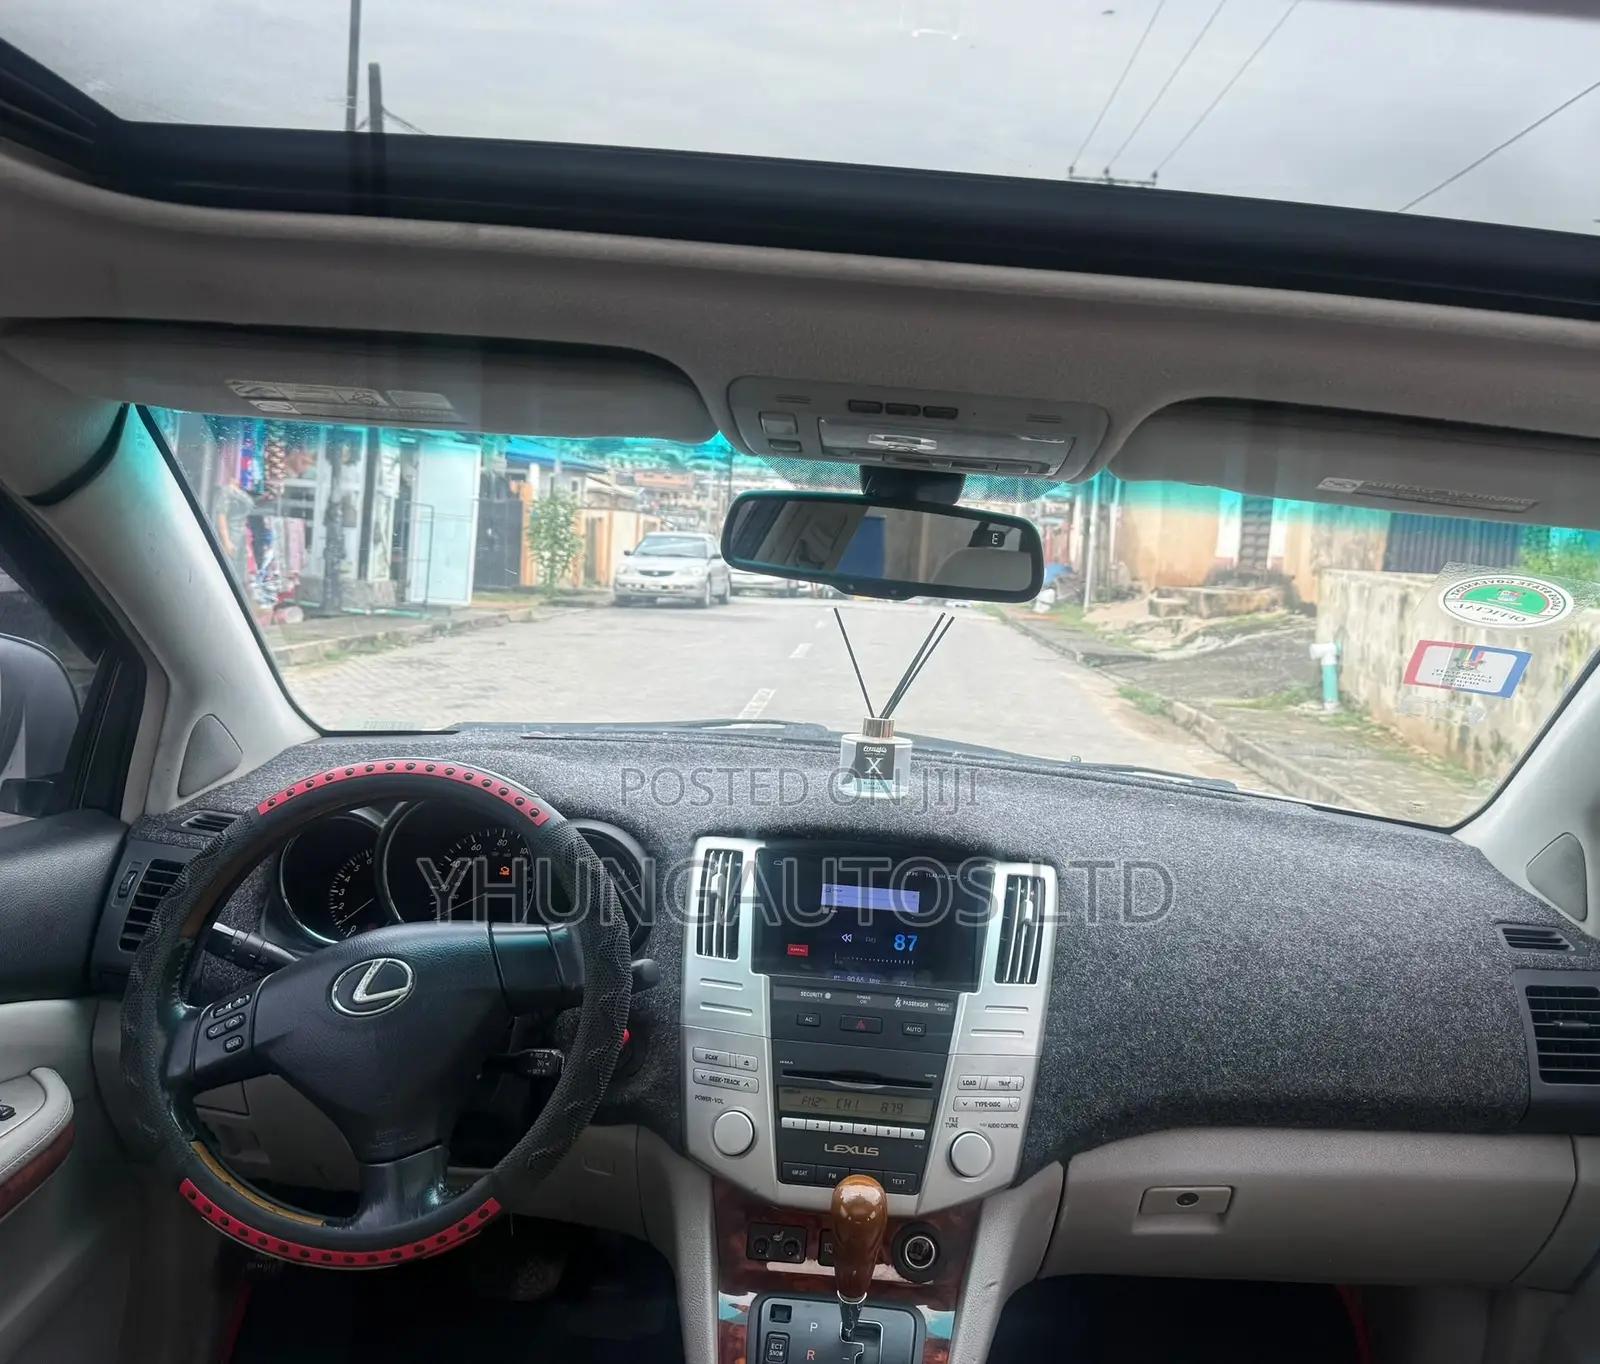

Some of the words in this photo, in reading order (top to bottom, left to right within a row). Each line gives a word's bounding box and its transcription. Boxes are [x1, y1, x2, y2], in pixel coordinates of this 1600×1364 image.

[991, 533, 999, 545] E
[865, 757, 884, 775] X
[893, 934, 919, 952] 87
[902, 1000, 929, 1008] PASSENGER
[704, 1053, 719, 1061] SCAN
[824, 1143, 880, 1157] LEXUS
[809, 1322, 818, 1332] P
[806, 1350, 815, 1360] R
